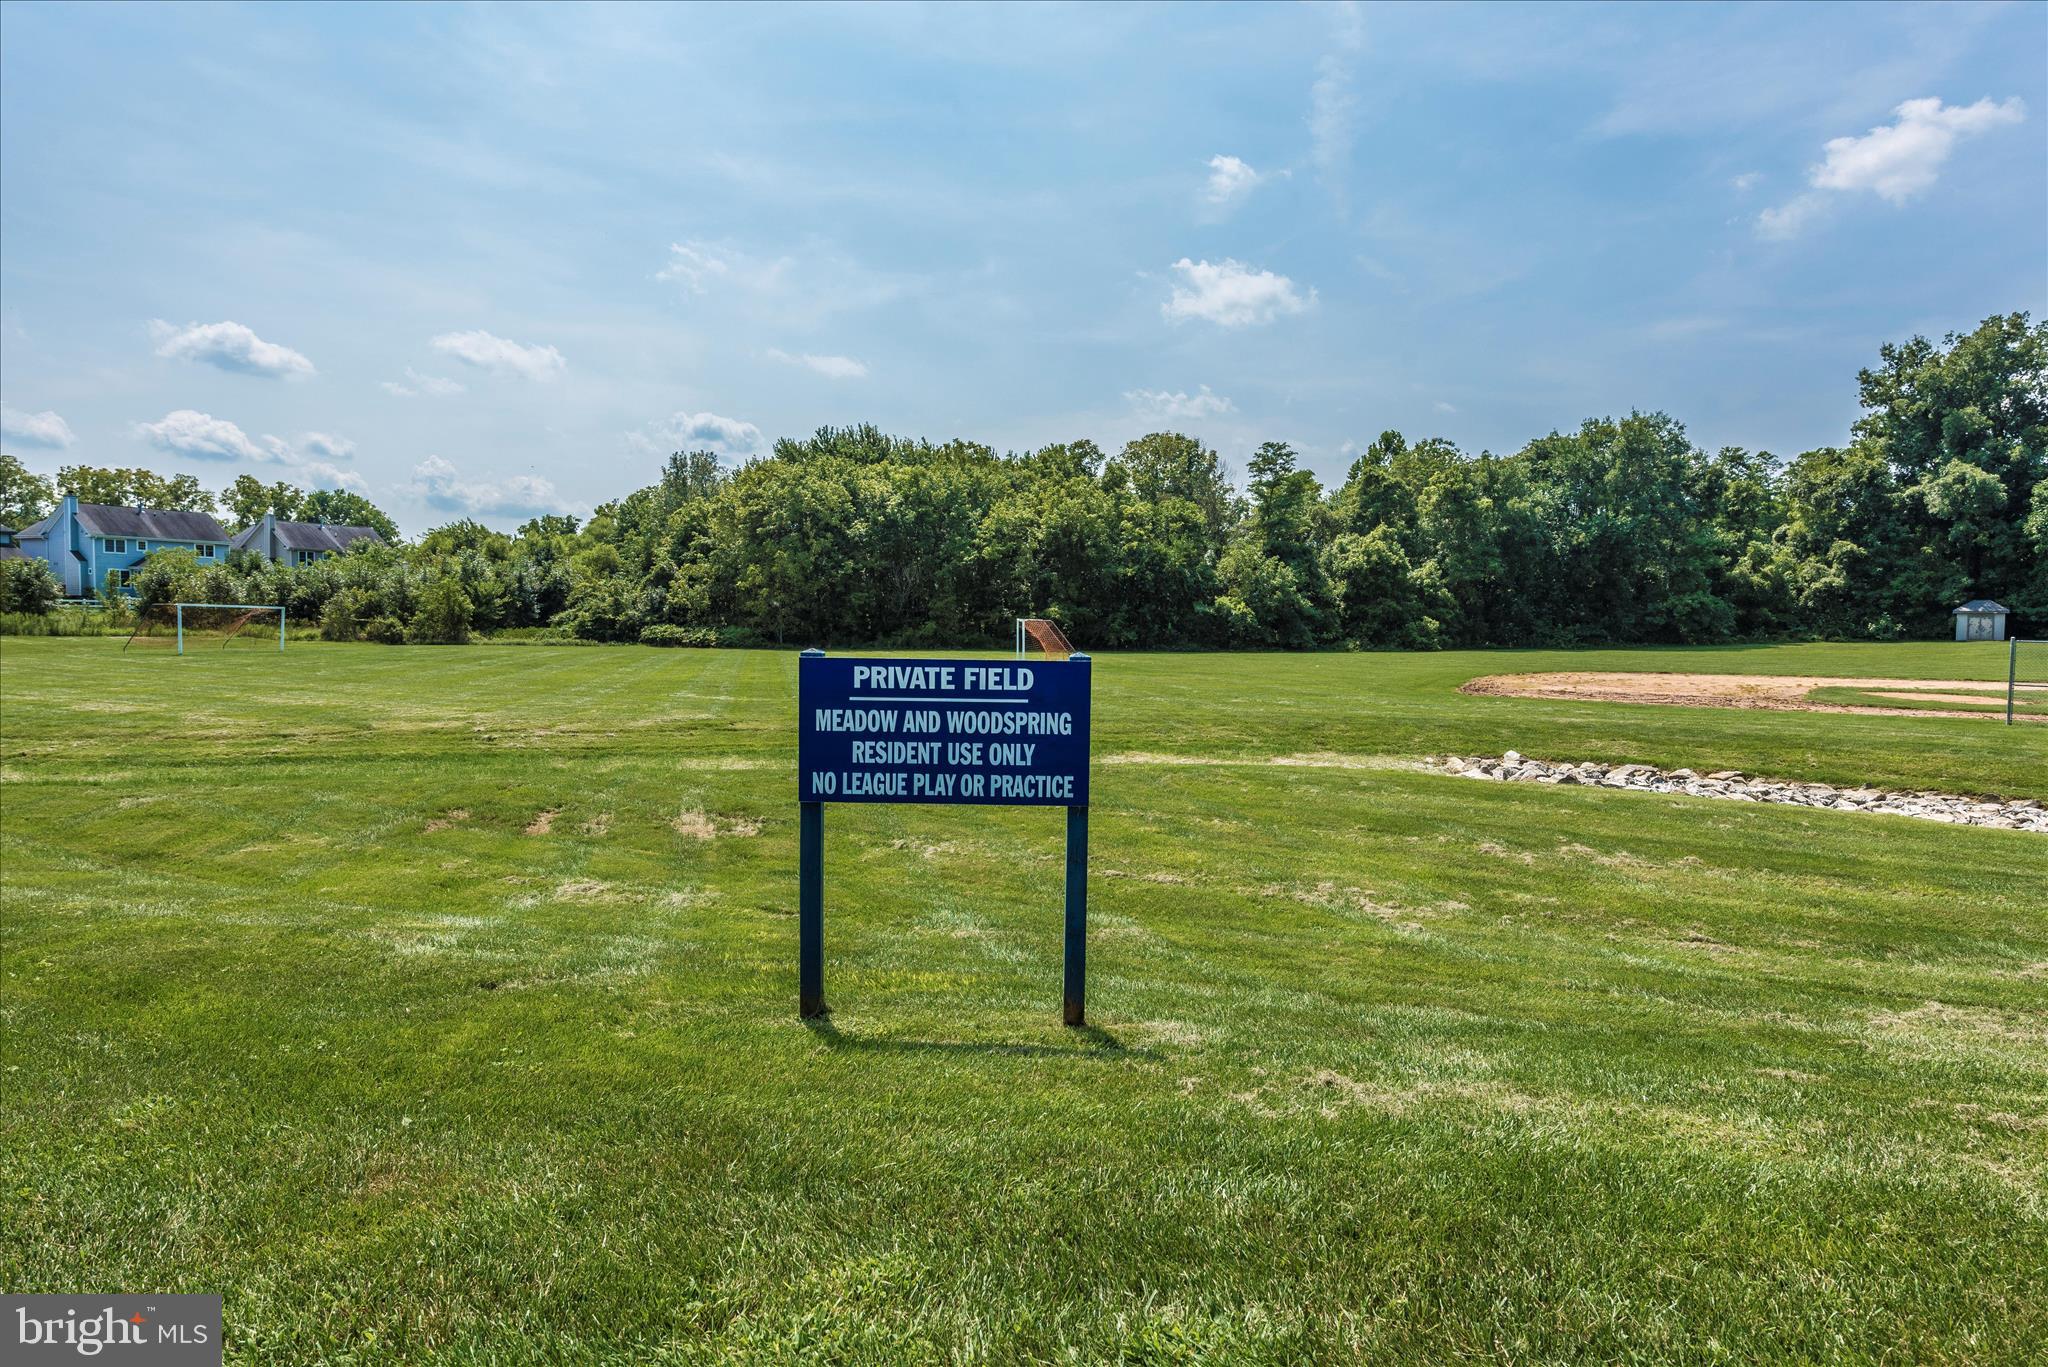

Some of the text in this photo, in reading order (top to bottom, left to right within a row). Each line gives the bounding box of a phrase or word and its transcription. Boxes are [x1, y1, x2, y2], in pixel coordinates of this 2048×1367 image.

[853, 666, 1035, 691] PRIVATE FIELD
[815, 709, 1072, 735] MEADOW AND WOODSPRING
[852, 741, 1036, 766] RESIDENT USE ONLY
[812, 771, 1074, 798] NO LEAGUE PLAY OR PRACTICE
